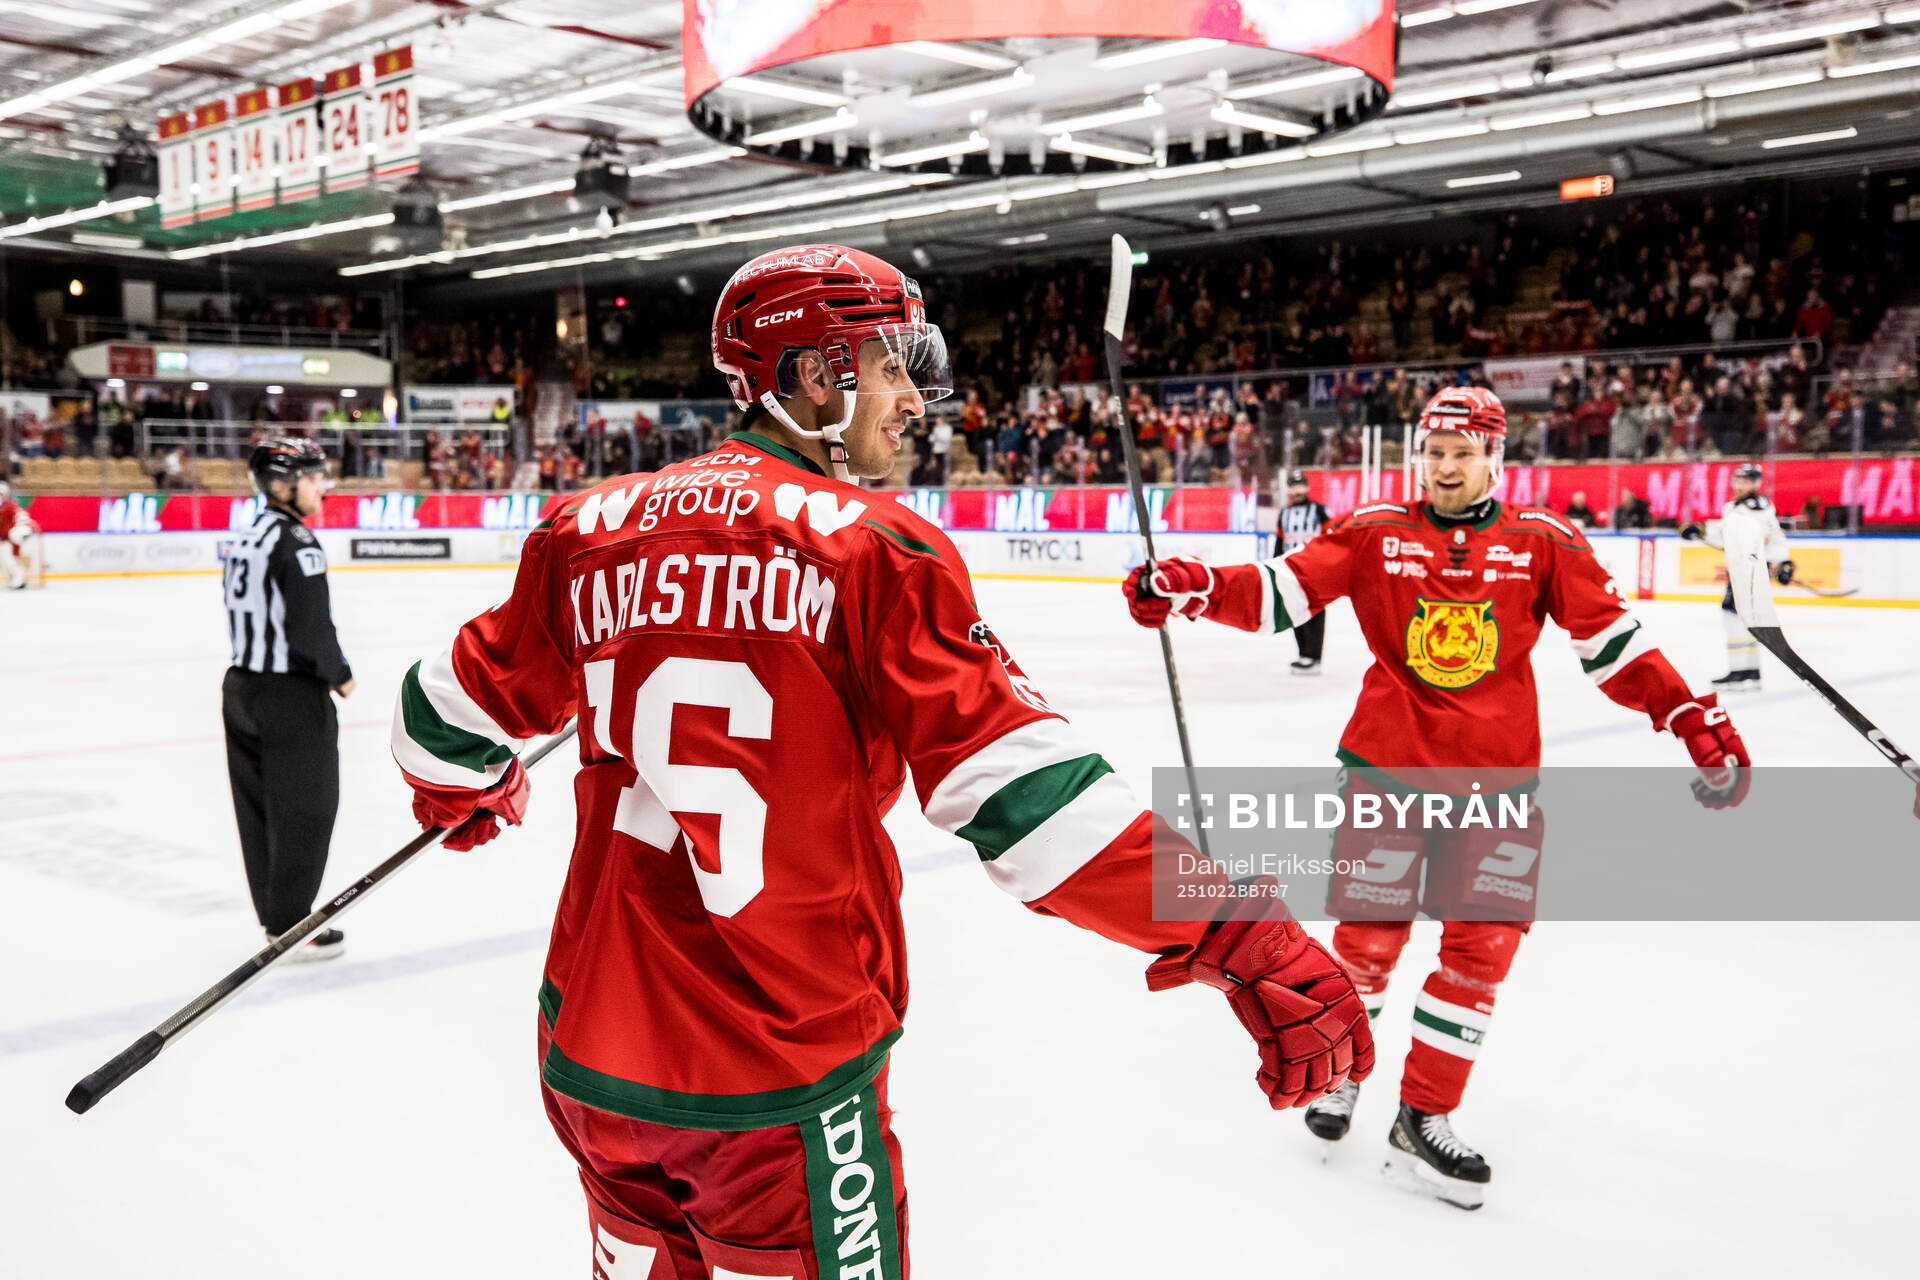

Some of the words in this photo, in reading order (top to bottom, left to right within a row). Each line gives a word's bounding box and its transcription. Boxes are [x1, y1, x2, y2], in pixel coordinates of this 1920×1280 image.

[331, 104, 360, 151] 24
[380, 87, 409, 137] 78
[207, 140, 218, 180] 9
[244, 128, 263, 171] 14
[286, 118, 307, 163] 17
[755, 308, 804, 328] CCM
[836, 379, 857, 389] CCM
[652, 469, 752, 493] wibe
[689, 453, 764, 468] CCM
[638, 487, 761, 532] group
[1840, 460, 1920, 520] MÅ
[571, 545, 837, 648] KARLSTRÖM
[583, 656, 774, 919] 16
